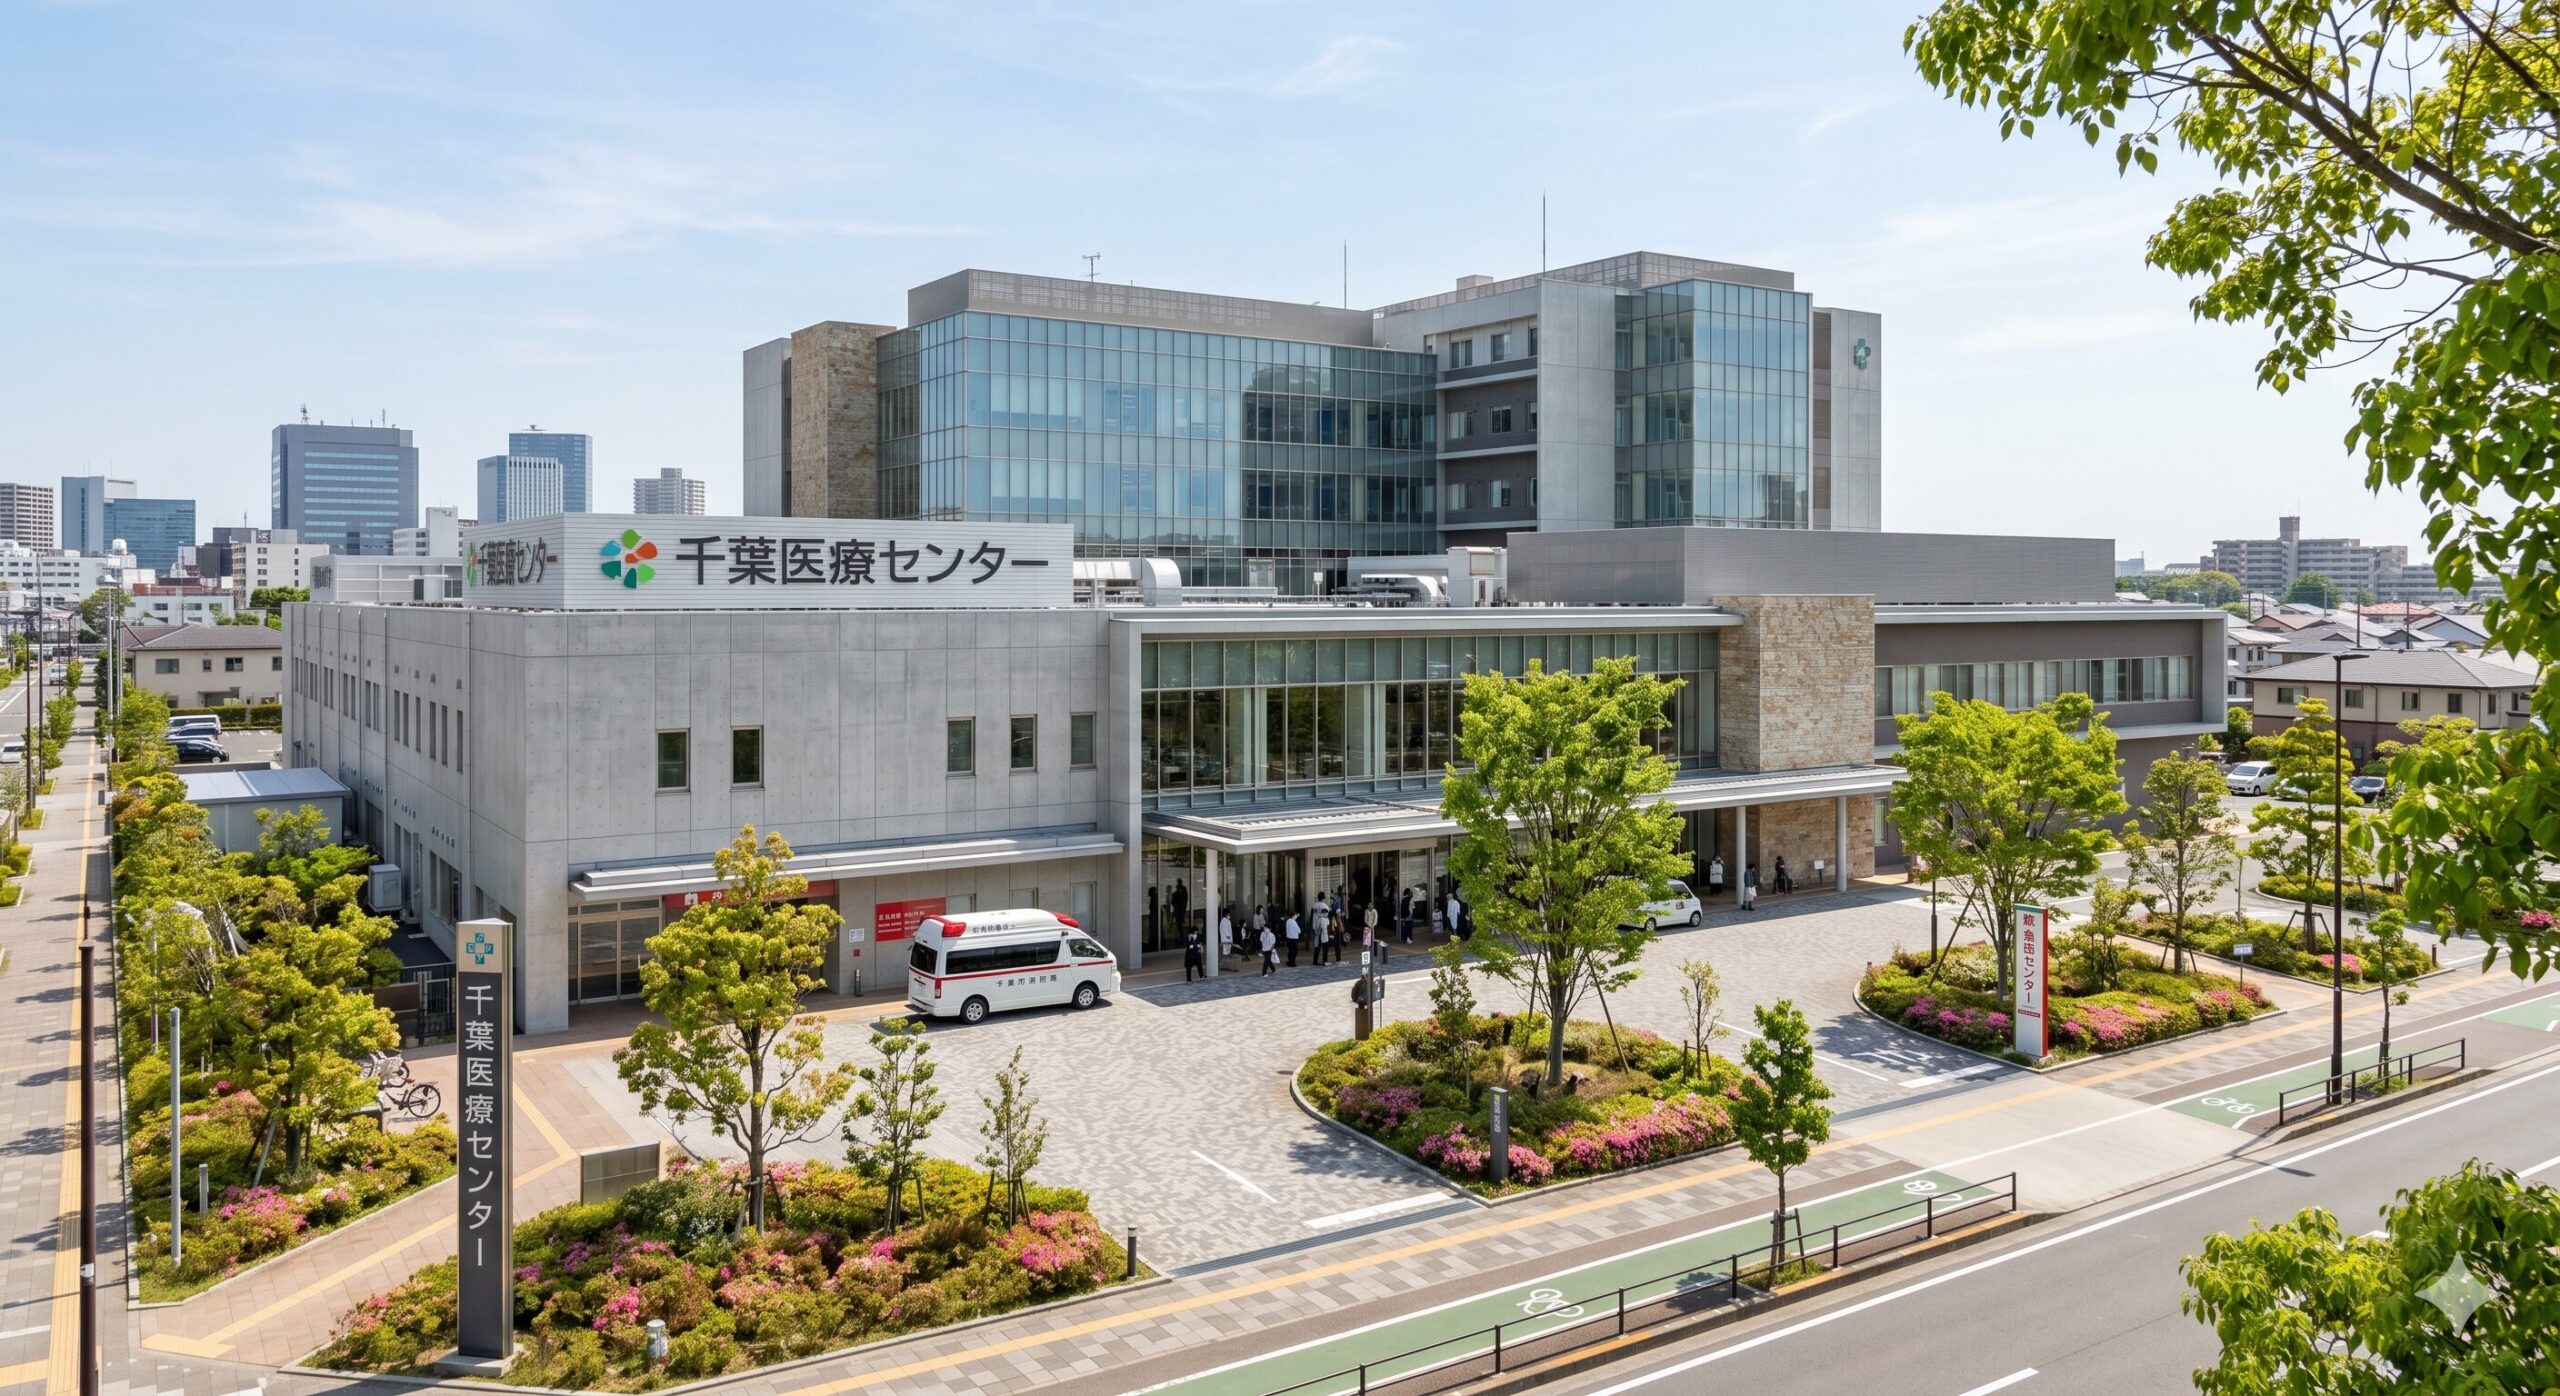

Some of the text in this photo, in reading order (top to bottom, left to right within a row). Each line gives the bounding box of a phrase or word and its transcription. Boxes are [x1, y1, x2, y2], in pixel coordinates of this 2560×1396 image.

[676, 536, 1049, 586] 千葉医療センター
[465, 985, 494, 1267] 千葉医療センター
